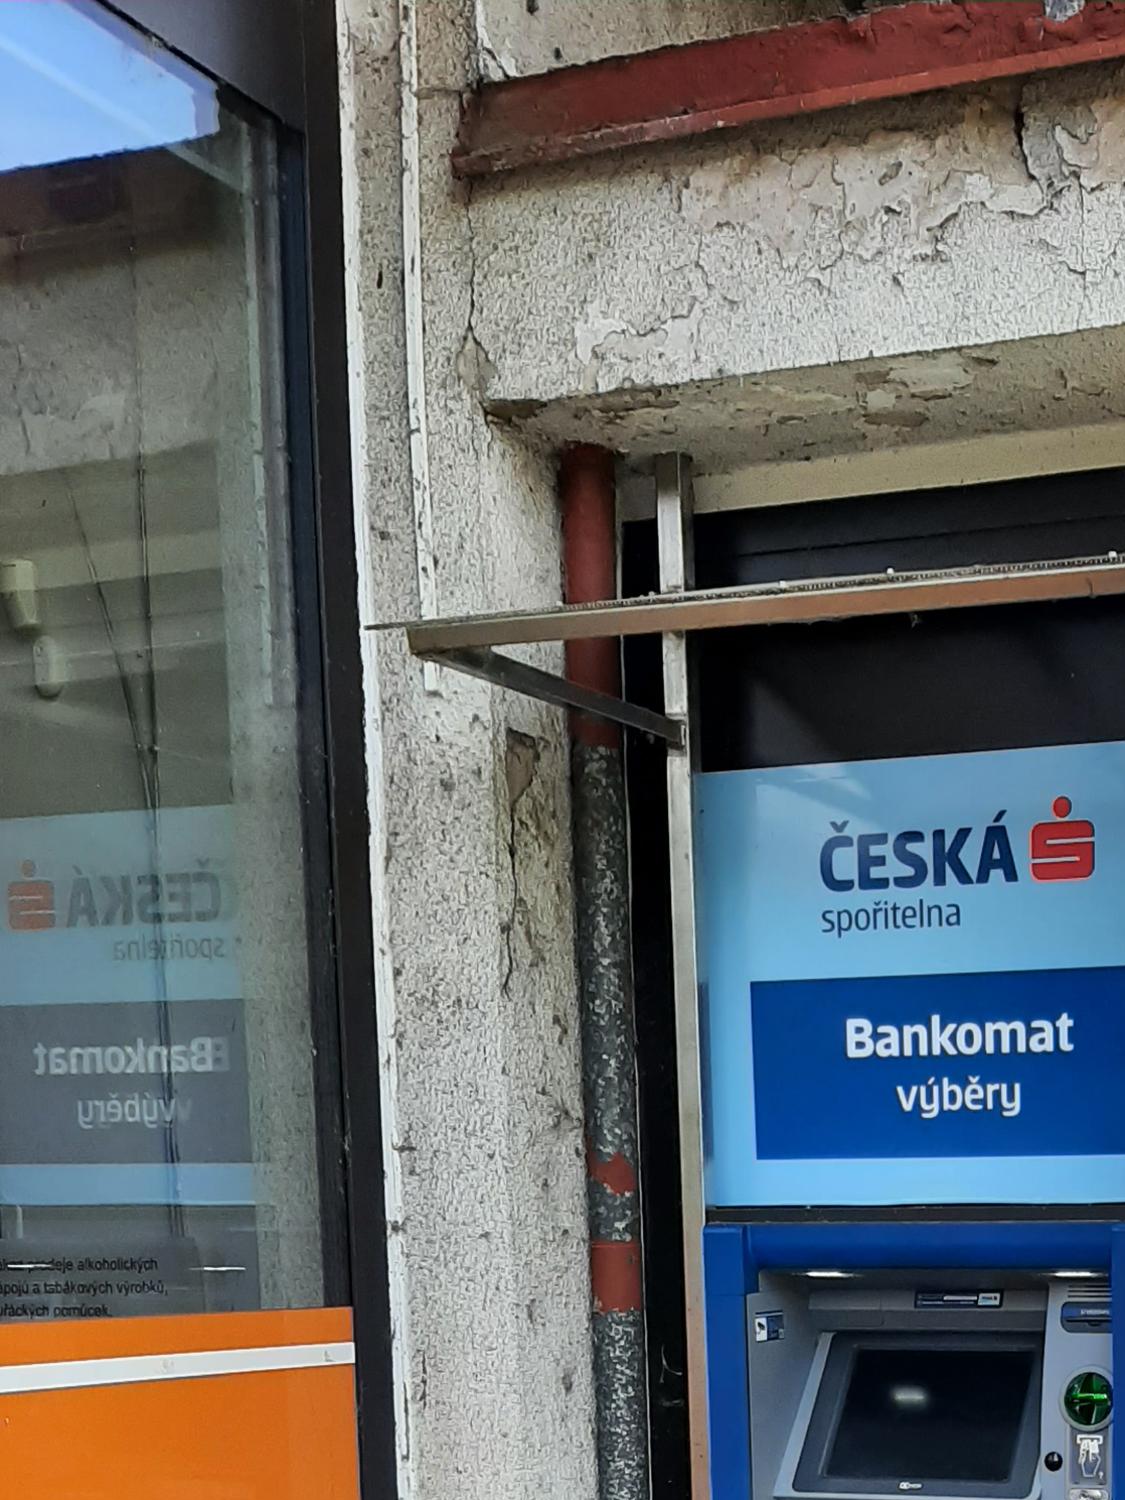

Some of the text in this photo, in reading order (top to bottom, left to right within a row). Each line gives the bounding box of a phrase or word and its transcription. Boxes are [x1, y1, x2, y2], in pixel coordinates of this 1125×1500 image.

[819, 810, 1018, 891] ČESKÁ
[821, 898, 961, 937] spořitelna
[845, 1012, 1074, 1059] Bankomat
[897, 1075, 1021, 1118] výběry
[77, 1257, 158, 1273] alkoholických
[32, 1283, 40, 1294] a
